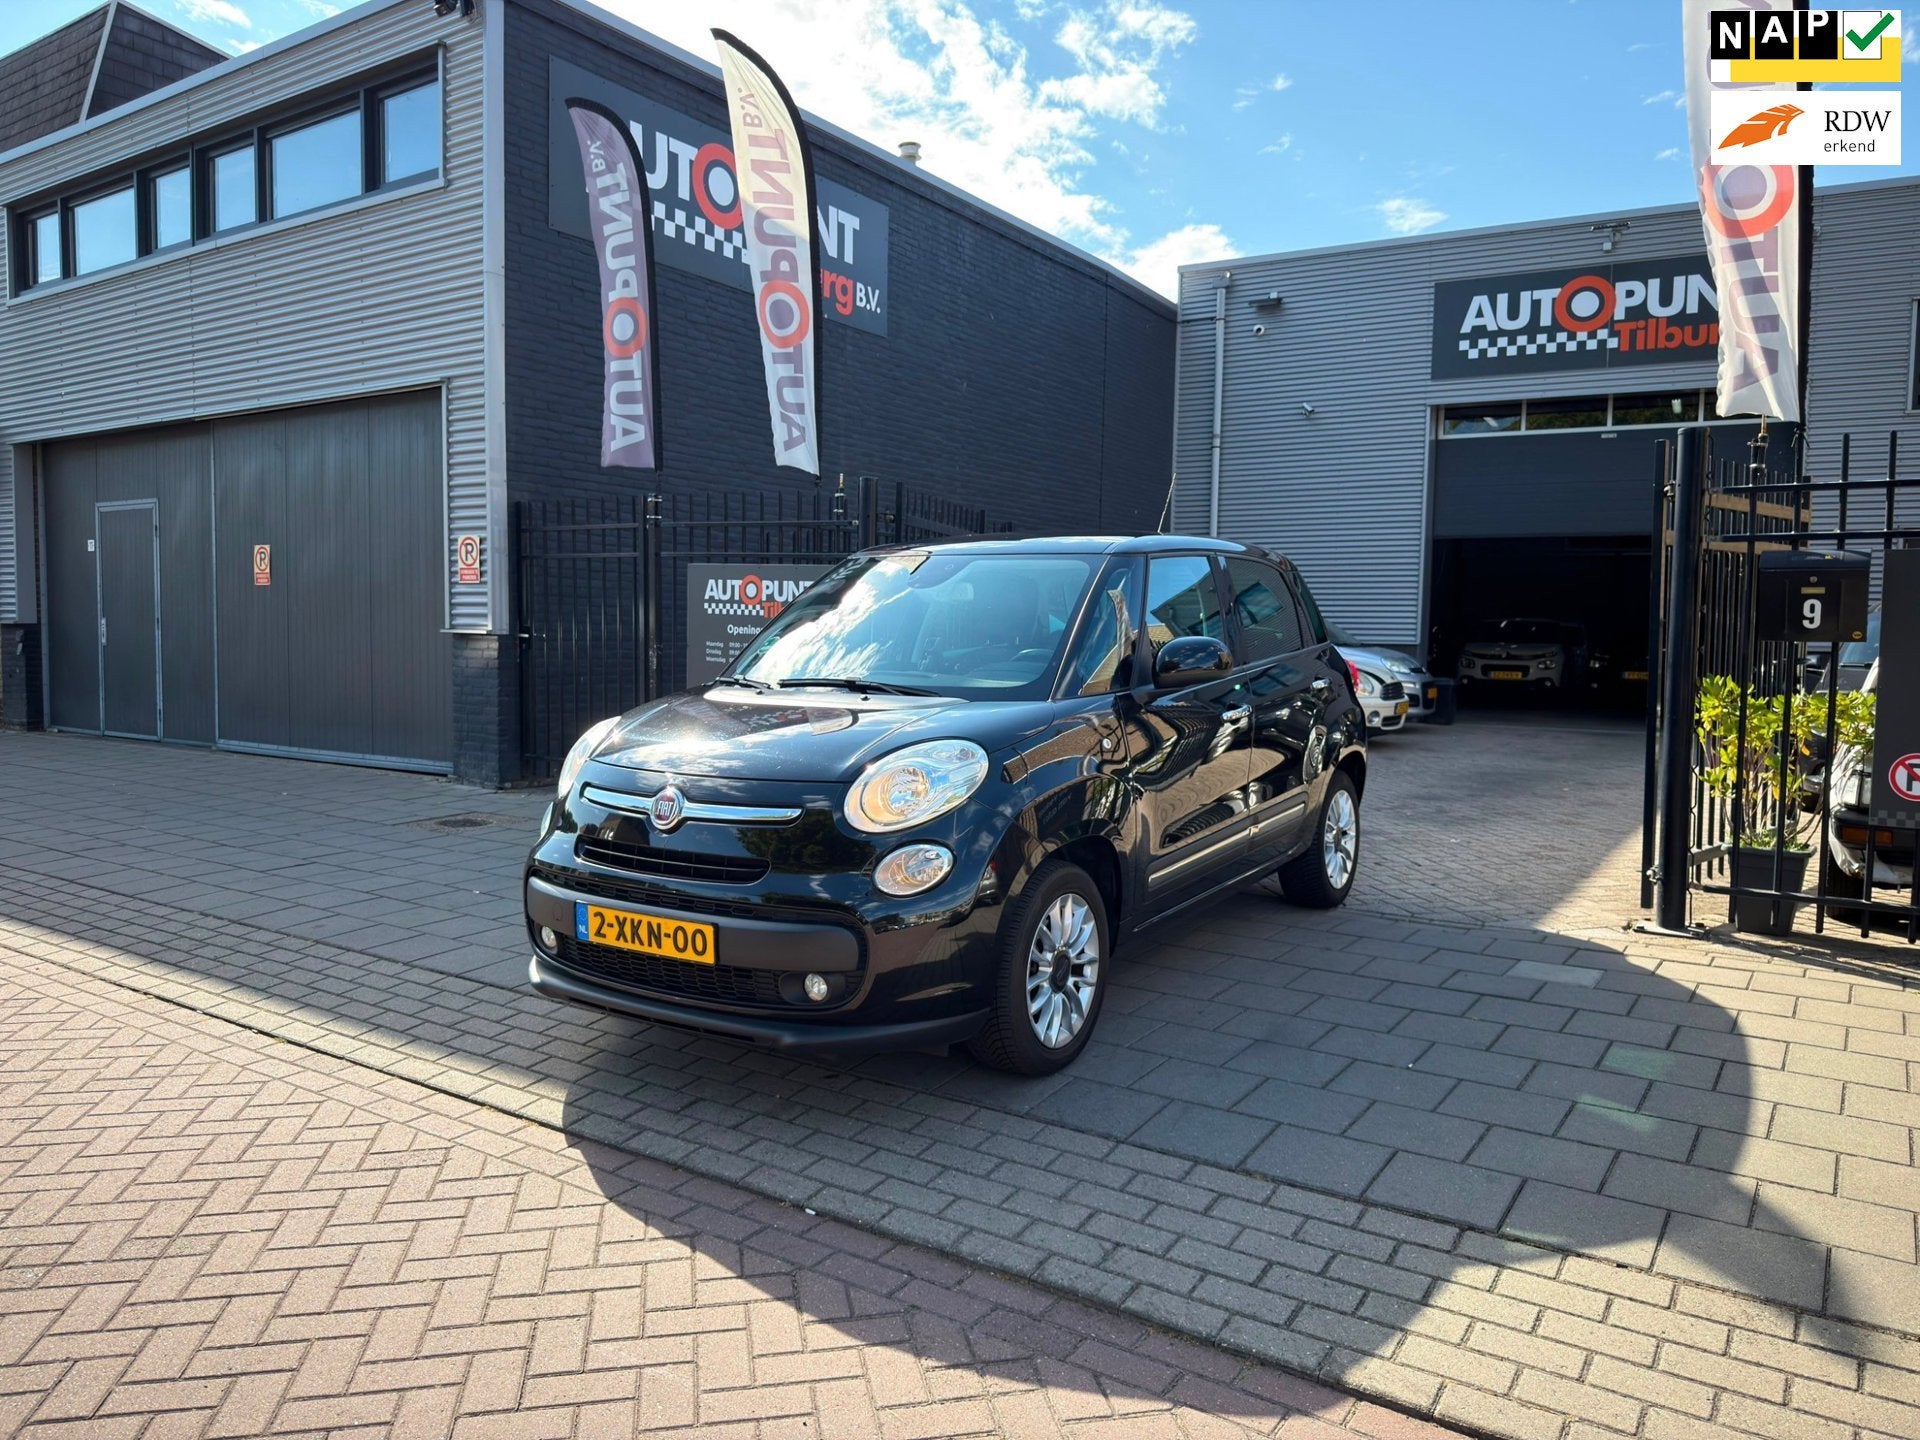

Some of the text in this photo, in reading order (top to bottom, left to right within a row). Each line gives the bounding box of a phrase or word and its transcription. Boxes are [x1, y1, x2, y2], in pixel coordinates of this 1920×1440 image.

[855, 289, 881, 313] B.V.
[1459, 275, 1719, 334] AUTOPUN
[1802, 598, 1822, 630] 9
[655, 800, 674, 817] FIAT
[593, 910, 708, 957] 2-XKN-00
